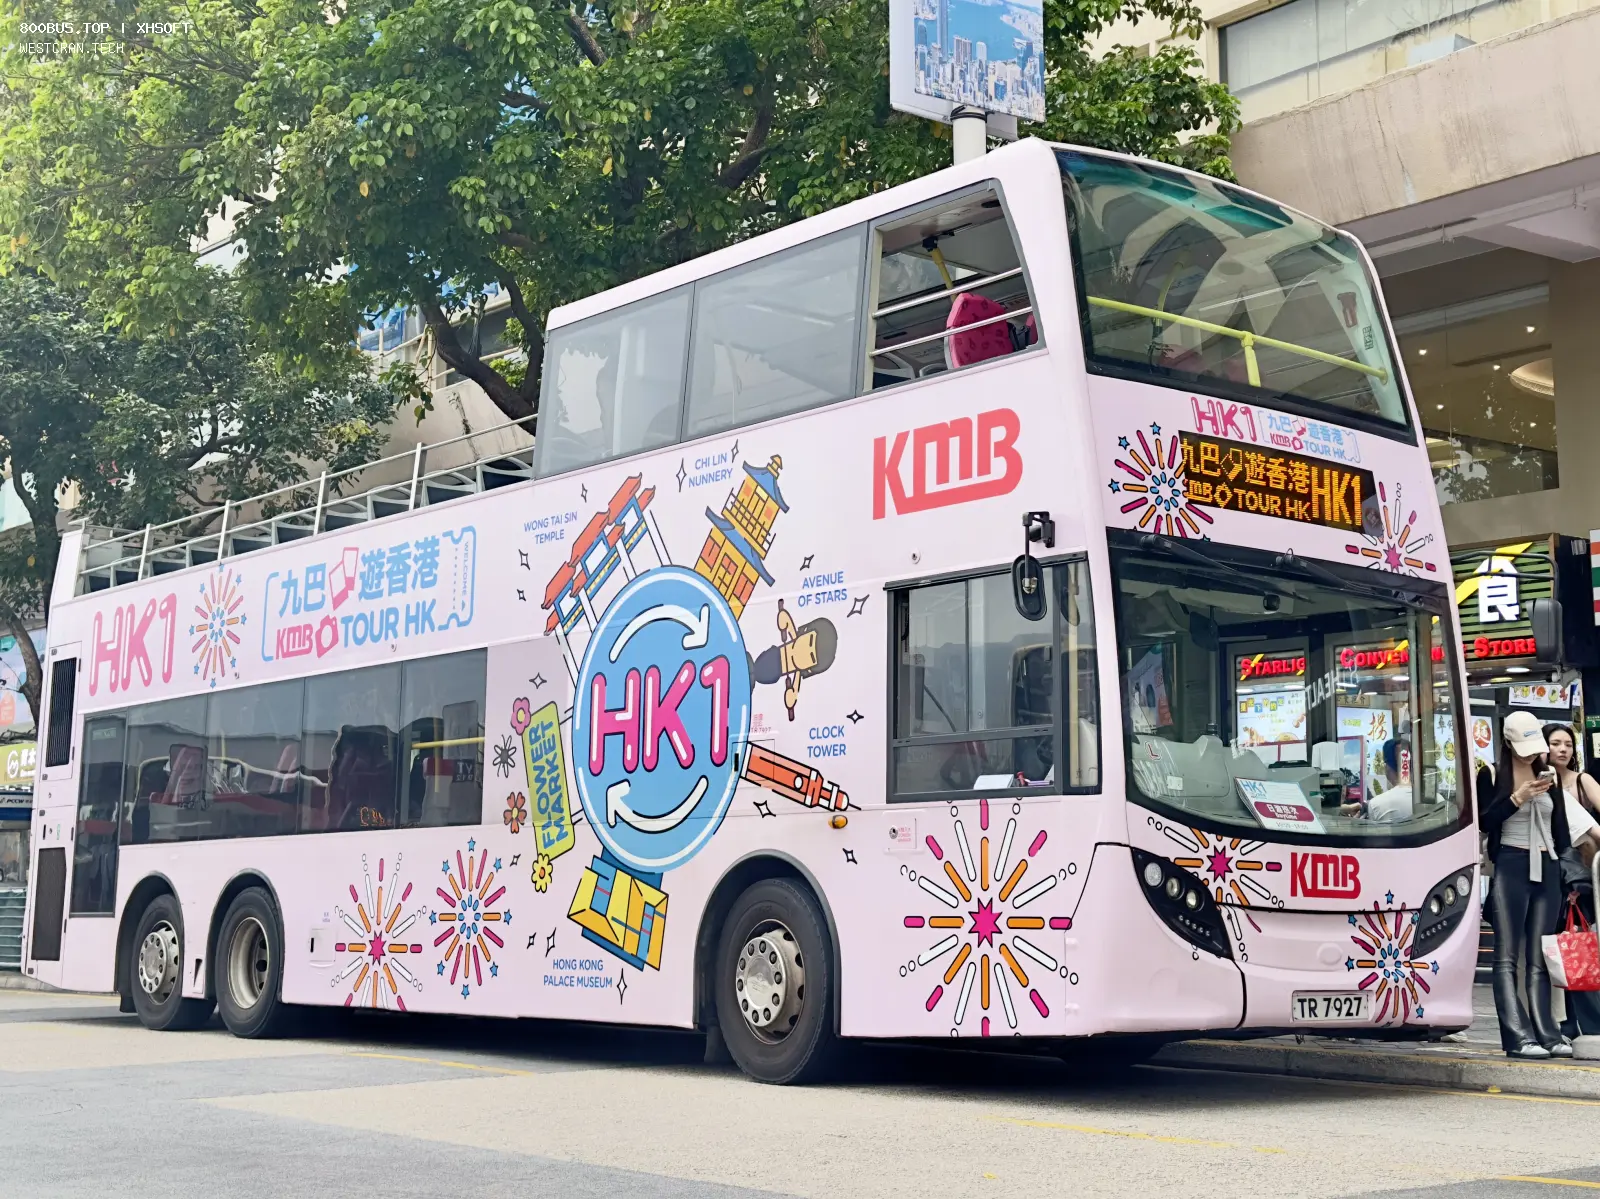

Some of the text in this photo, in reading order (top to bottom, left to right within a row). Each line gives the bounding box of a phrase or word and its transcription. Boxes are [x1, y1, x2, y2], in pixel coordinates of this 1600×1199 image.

[1191, 397, 1257, 442] HK1
[1267, 413, 1293, 433] 九巴
[695, 452, 727, 470] CHI LIN
[872, 407, 1023, 520] KMB
[1270, 433, 1345, 458] KMB TOUR HK
[688, 467, 733, 488] NUNNERY
[1180, 438, 1309, 494] 九巴 遊香港
[1184, 479, 1312, 521] MB TOUR HK
[1311, 466, 1362, 526] HK1
[524, 511, 578, 532] WONG TAI SIN
[535, 529, 565, 544] TEMPLE
[279, 535, 440, 618] 九巴 遊香港
[461, 541, 469, 596] WELCOME
[802, 571, 844, 589] AVENUE
[798, 588, 848, 607] OF STARS
[88, 592, 178, 697] HK1
[275, 598, 437, 660] KMB TOUR HK
[1240, 657, 1306, 677] STARLIG
[1474, 637, 1536, 658] STORE
[590, 655, 731, 776] HK1
[809, 725, 845, 740] CLOCK
[807, 743, 847, 758] TOWER
[529, 724, 555, 849] FLOWER
[541, 721, 569, 842] MARKET
[1290, 852, 1361, 899] KMB
[543, 974, 613, 988] PALACE MUSEUM
[553, 958, 604, 971] HONG KONG
[1297, 996, 1362, 1018] TR 7927
